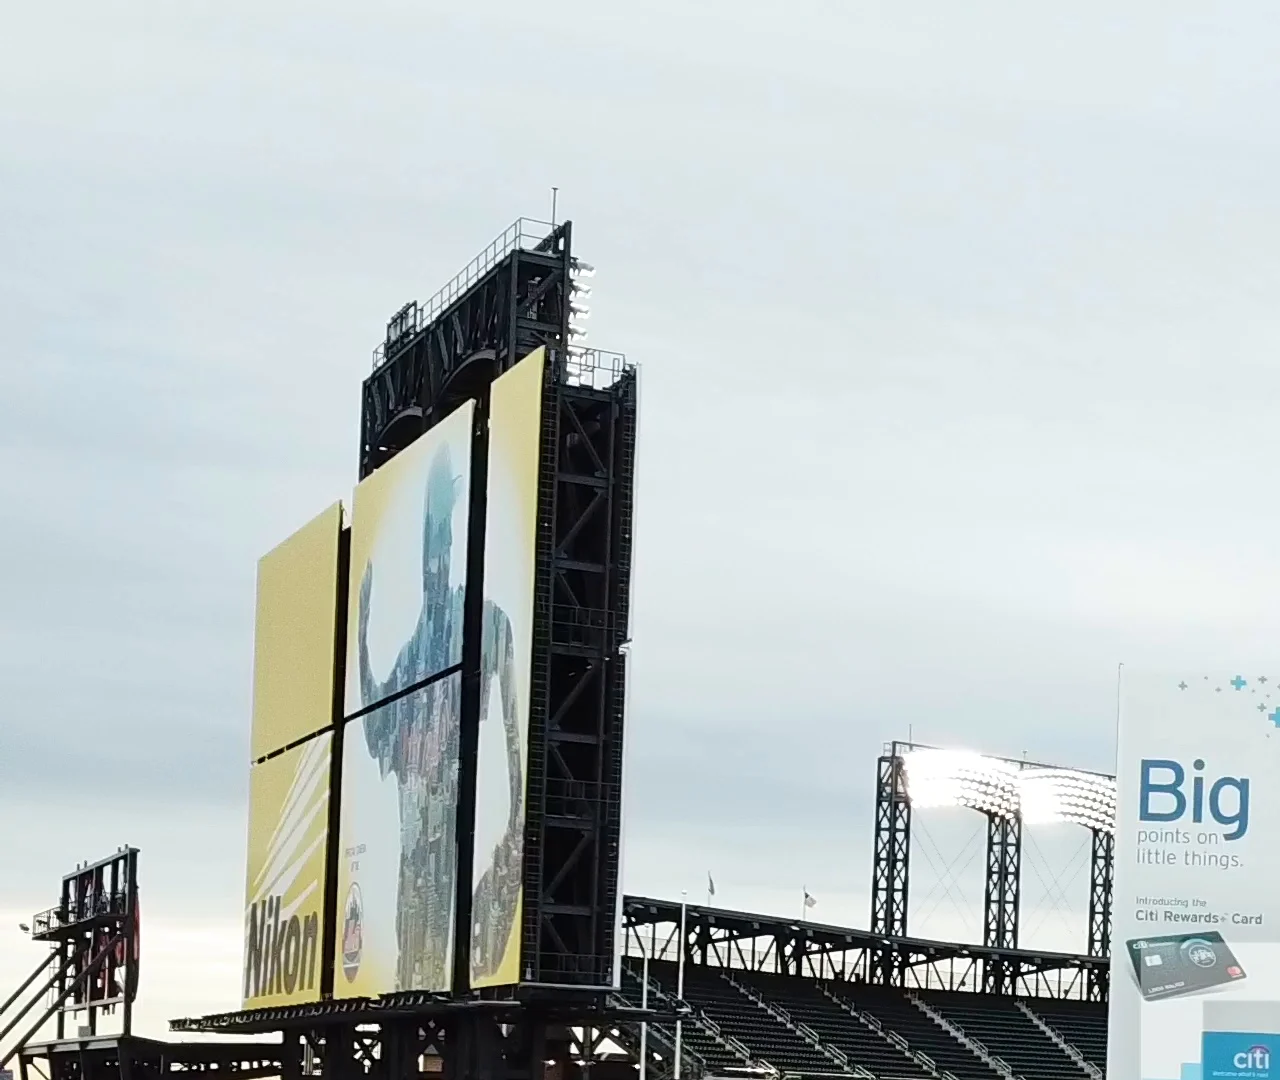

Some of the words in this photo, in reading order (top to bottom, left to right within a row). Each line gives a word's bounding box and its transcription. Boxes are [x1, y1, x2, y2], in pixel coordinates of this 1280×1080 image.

[1138, 757, 1250, 841] Big
[1136, 827, 1191, 849] points
[1197, 832, 1218, 845] on
[1136, 846, 1177, 866] little
[1184, 849, 1244, 870] things.
[1135, 895, 1189, 910] Introducing
[1192, 897, 1207, 908] the
[1135, 909, 1159, 922] Citi
[1231, 912, 1263, 925] Card
[244, 892, 320, 999] Nikon
[1233, 1049, 1270, 1069] citi
